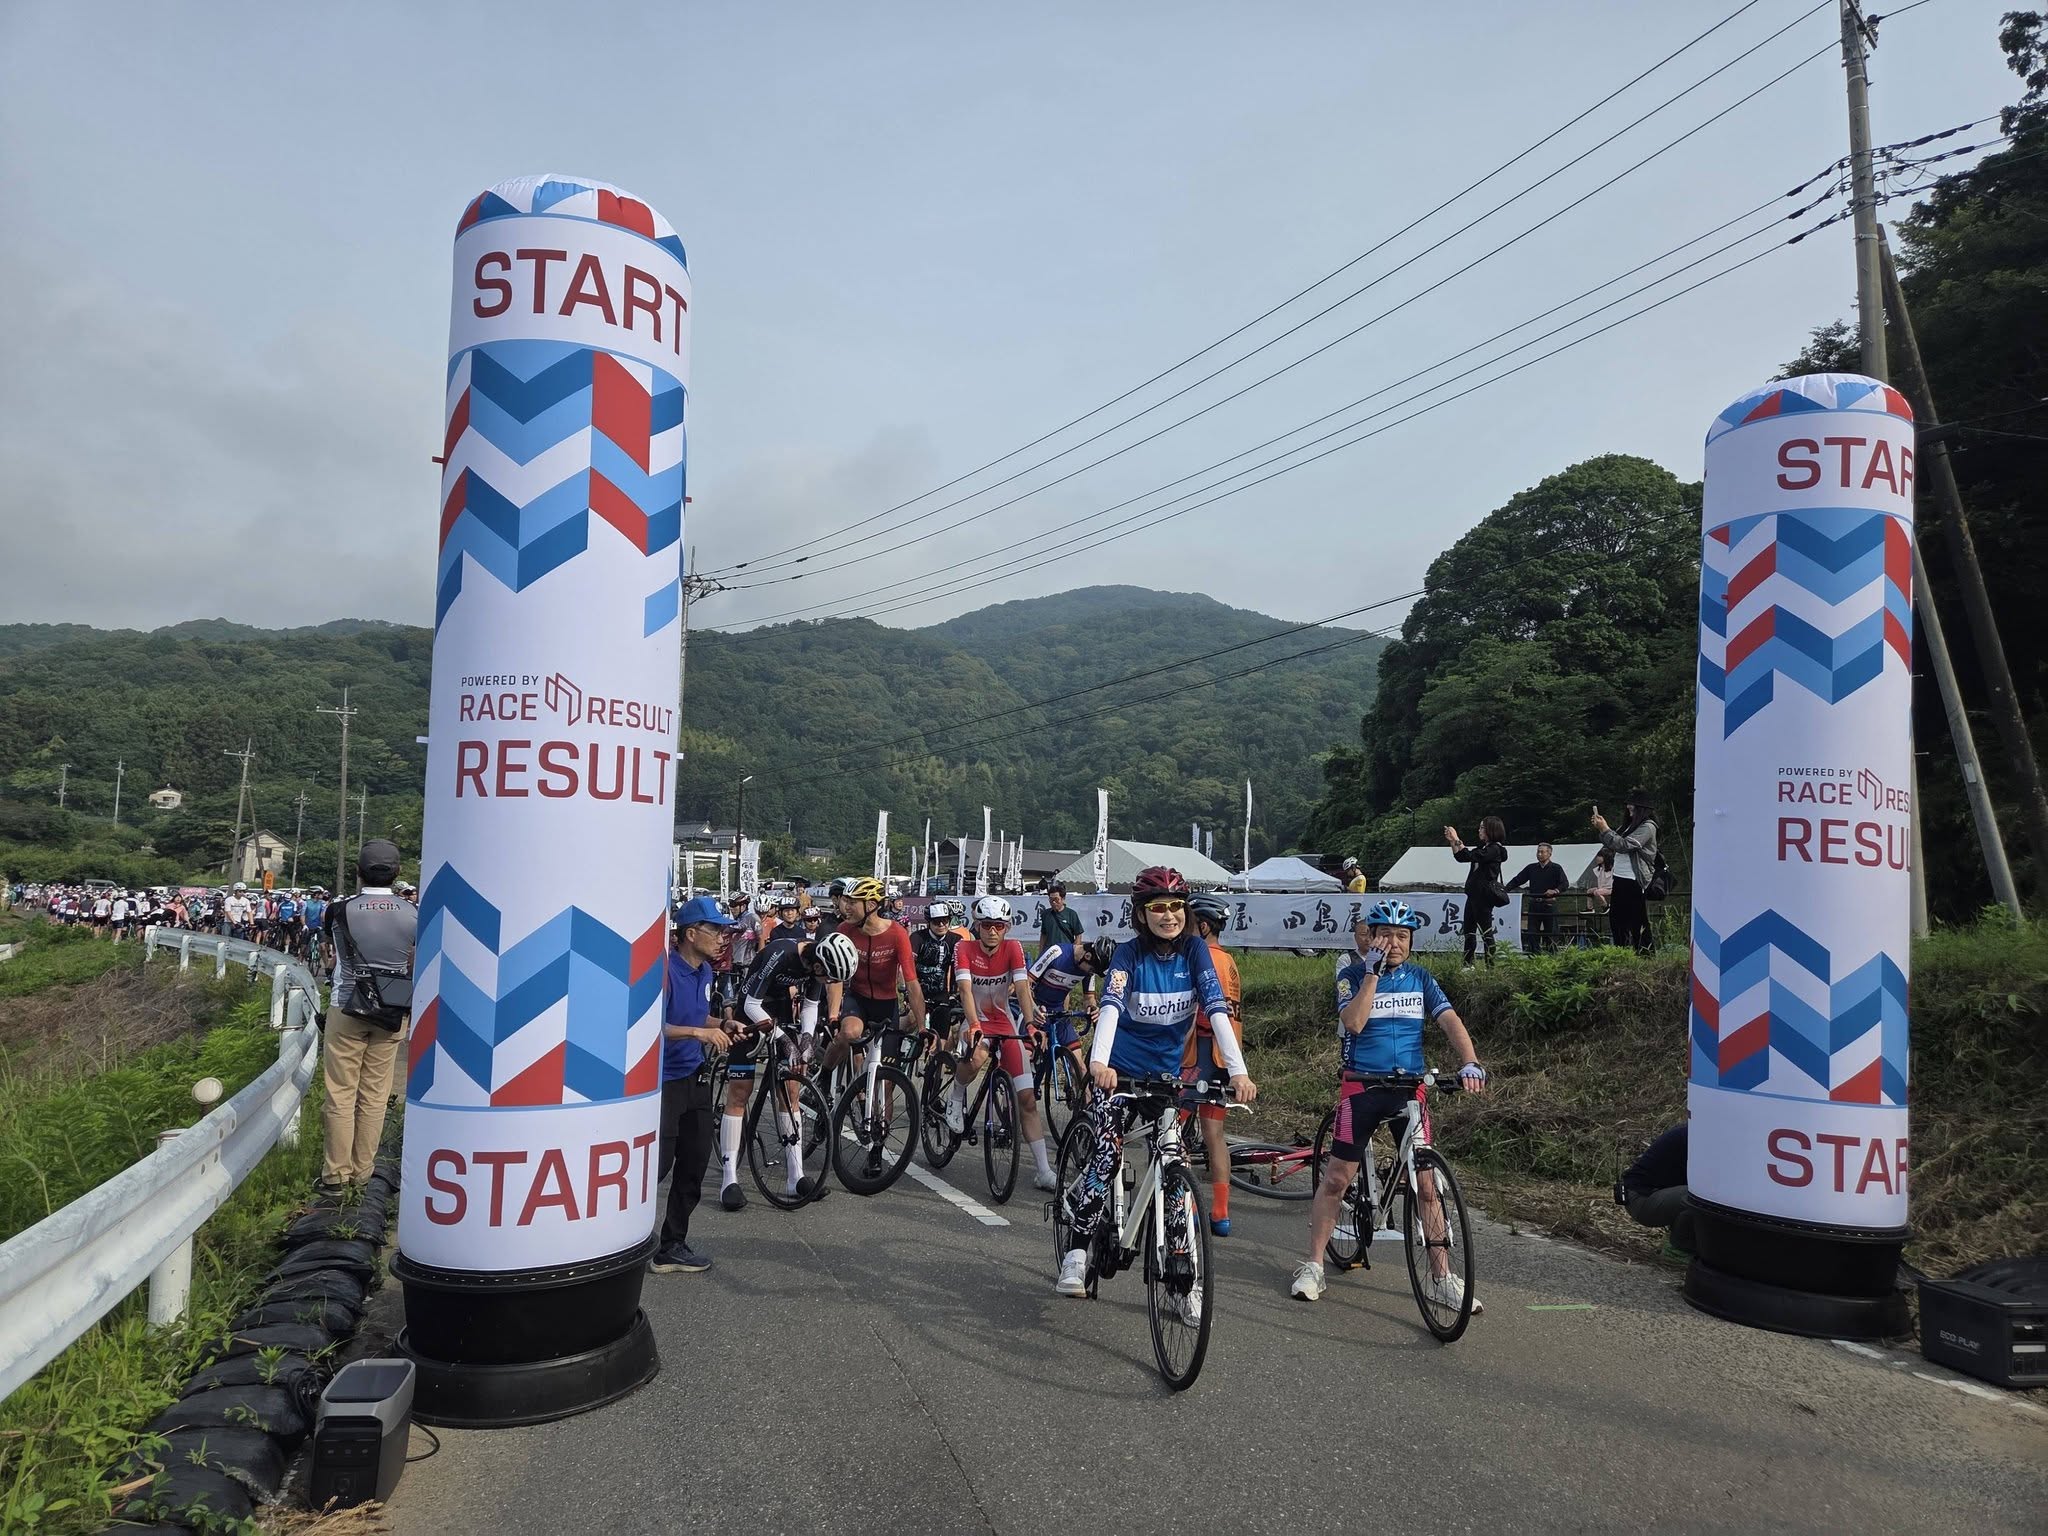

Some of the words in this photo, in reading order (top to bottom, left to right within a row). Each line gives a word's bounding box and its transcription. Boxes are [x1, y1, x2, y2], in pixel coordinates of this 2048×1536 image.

[473, 248, 687, 356] START
[1776, 436, 1913, 500] STAR
[461, 675, 516, 687] POWERED
[521, 675, 539, 686] BY
[459, 693, 539, 722] RACE
[587, 696, 673, 735] RESULT
[455, 739, 671, 806] RESULT
[1778, 767, 1834, 777] POWERED
[1839, 769, 1853, 778] BY
[1778, 781, 1853, 805] RACE
[1886, 787, 1911, 814] RES
[1371, 996, 1422, 1010] suchiura
[425, 1130, 656, 1227] START
[1767, 1128, 1908, 1195] STAR
